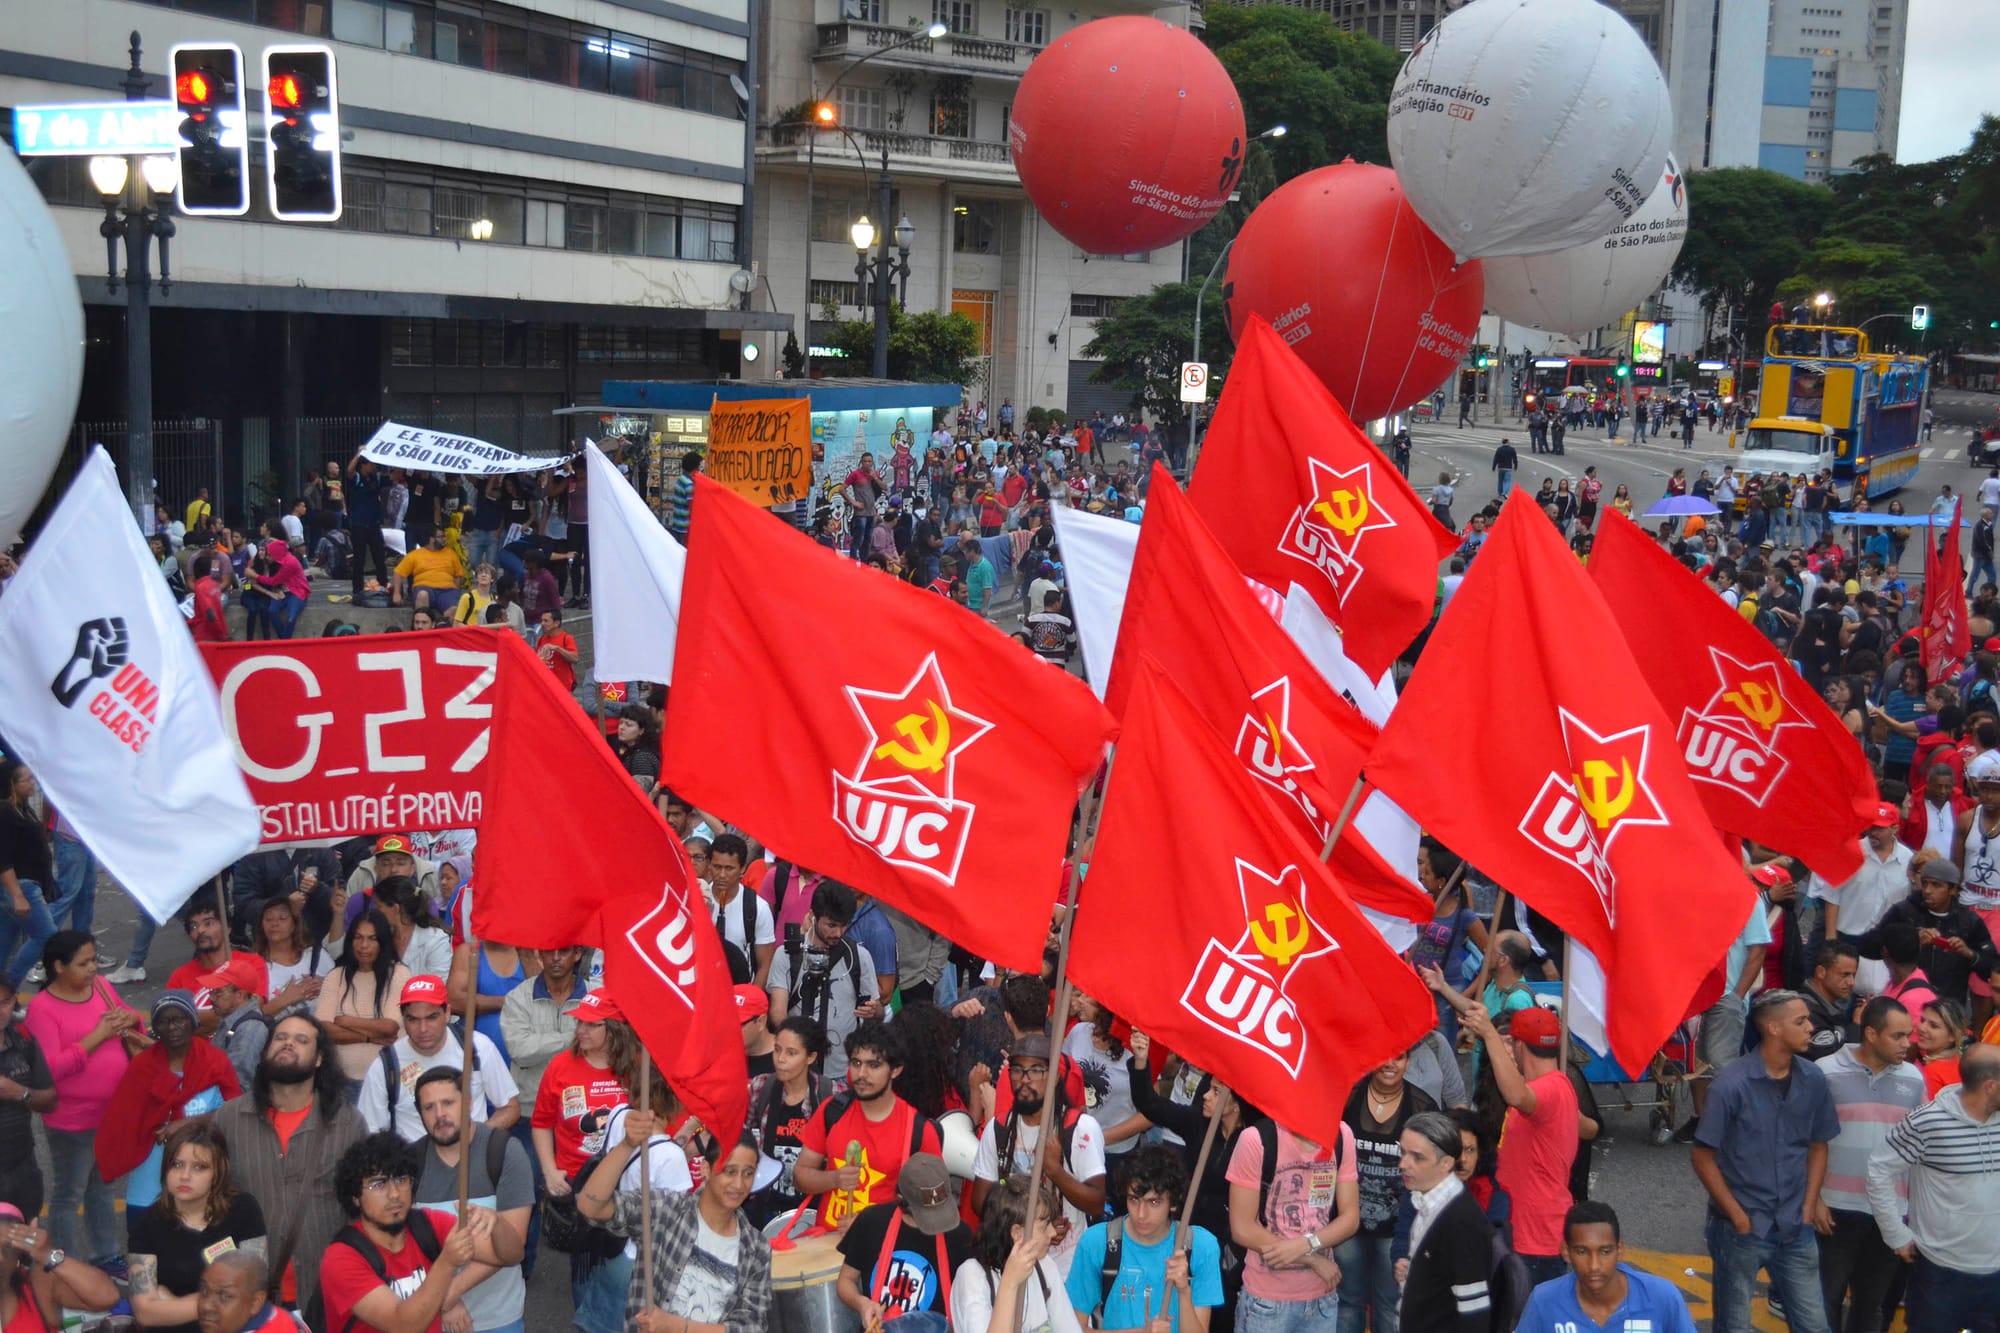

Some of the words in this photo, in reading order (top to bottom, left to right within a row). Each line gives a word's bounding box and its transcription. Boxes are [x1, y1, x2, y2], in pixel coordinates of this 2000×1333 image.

[1416, 79, 1491, 106] Financiários
[19, 112, 42, 147] 7
[49, 112, 89, 147] de
[1128, 179, 1181, 204] Sindicato
[1181, 194, 1201, 210] dos
[1132, 194, 1147, 206] de
[1146, 197, 1168, 214] São
[1649, 218, 1665, 230] dos
[1604, 238, 1618, 250] de
[1620, 236, 1640, 248] São
[1272, 302, 1312, 333] ciários
[1417, 311, 1464, 344] Sindicato
[1419, 336, 1436, 351] de
[396, 444, 430, 460] SÃO
[433, 453, 472, 471] LUÍS
[1685, 724, 1766, 783] UJC
[846, 792, 949, 860] UJC
[1205, 961, 1297, 1048] UJC
[1358, 1162, 1402, 1177] YOURSEL
